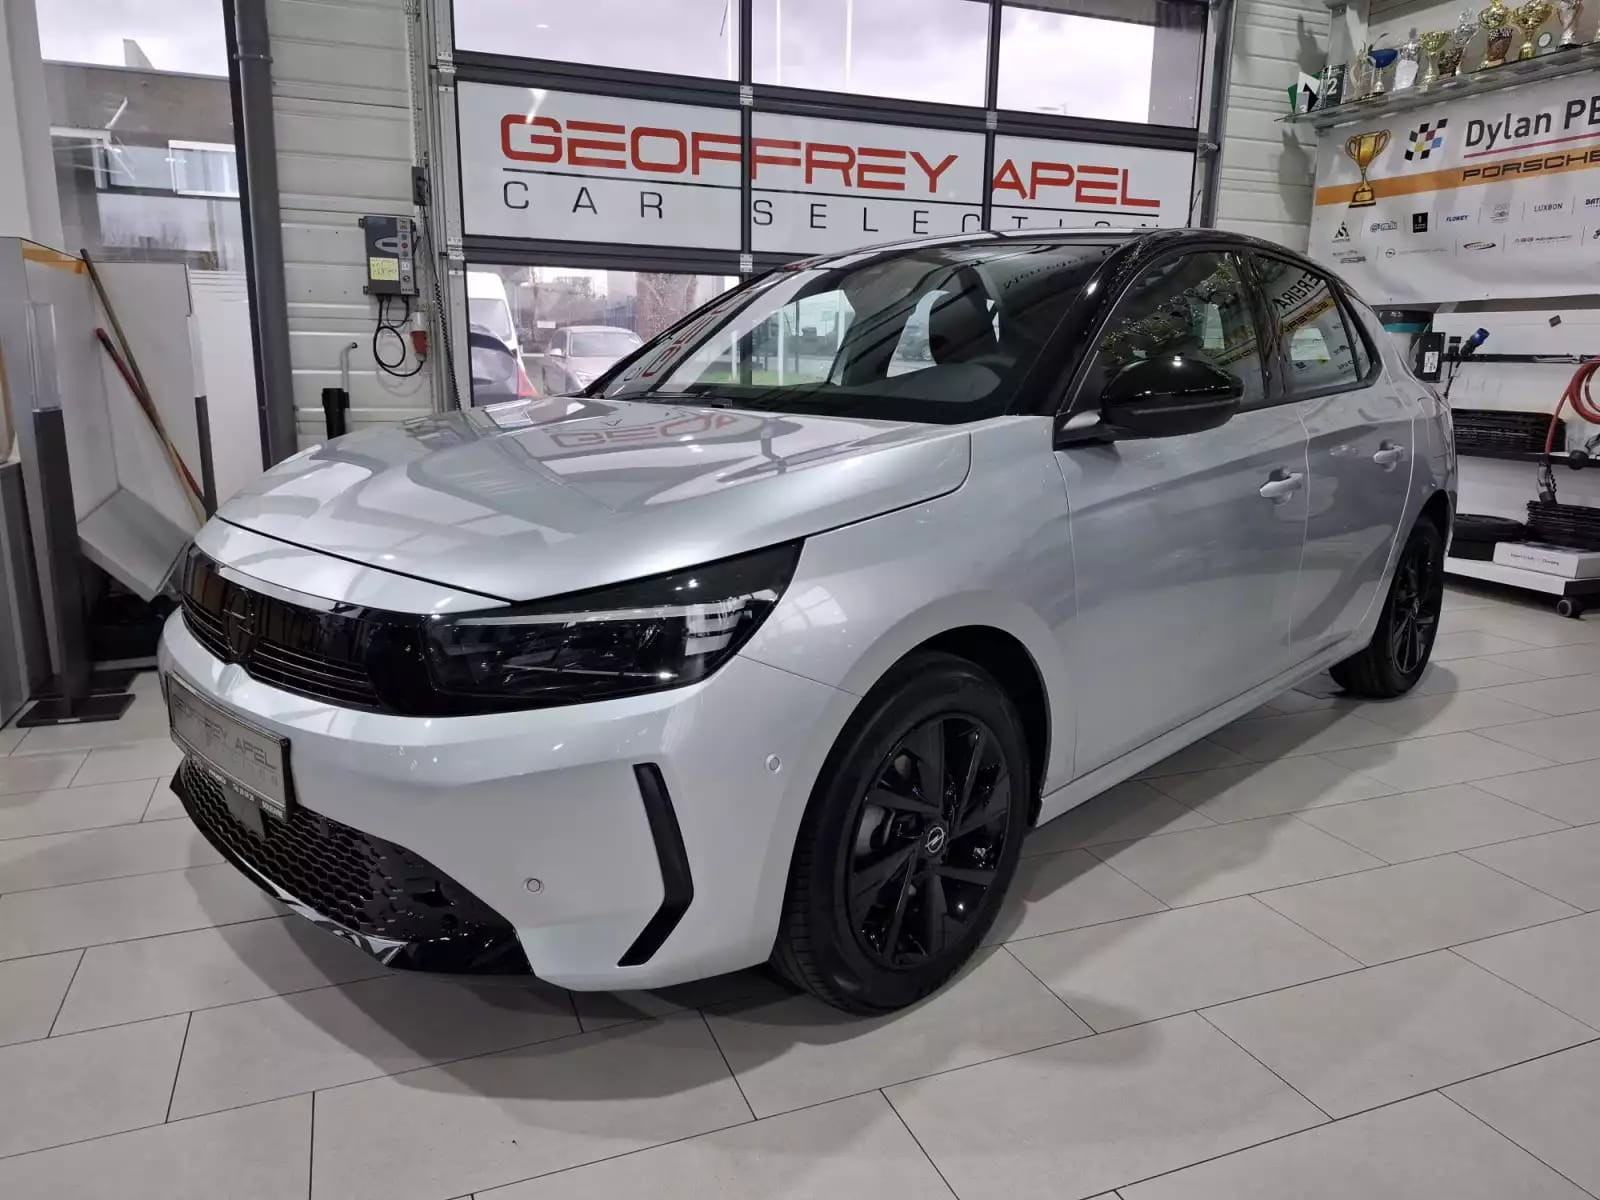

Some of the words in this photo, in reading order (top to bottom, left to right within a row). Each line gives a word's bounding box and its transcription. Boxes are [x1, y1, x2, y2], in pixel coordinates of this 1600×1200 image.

[1465, 112, 1552, 150] Dylan
[501, 113, 958, 193] GEOFFREY
[993, 158, 1160, 208] APEL
[503, 181, 663, 219] CAR
[752, 199, 1159, 235] SELECT
